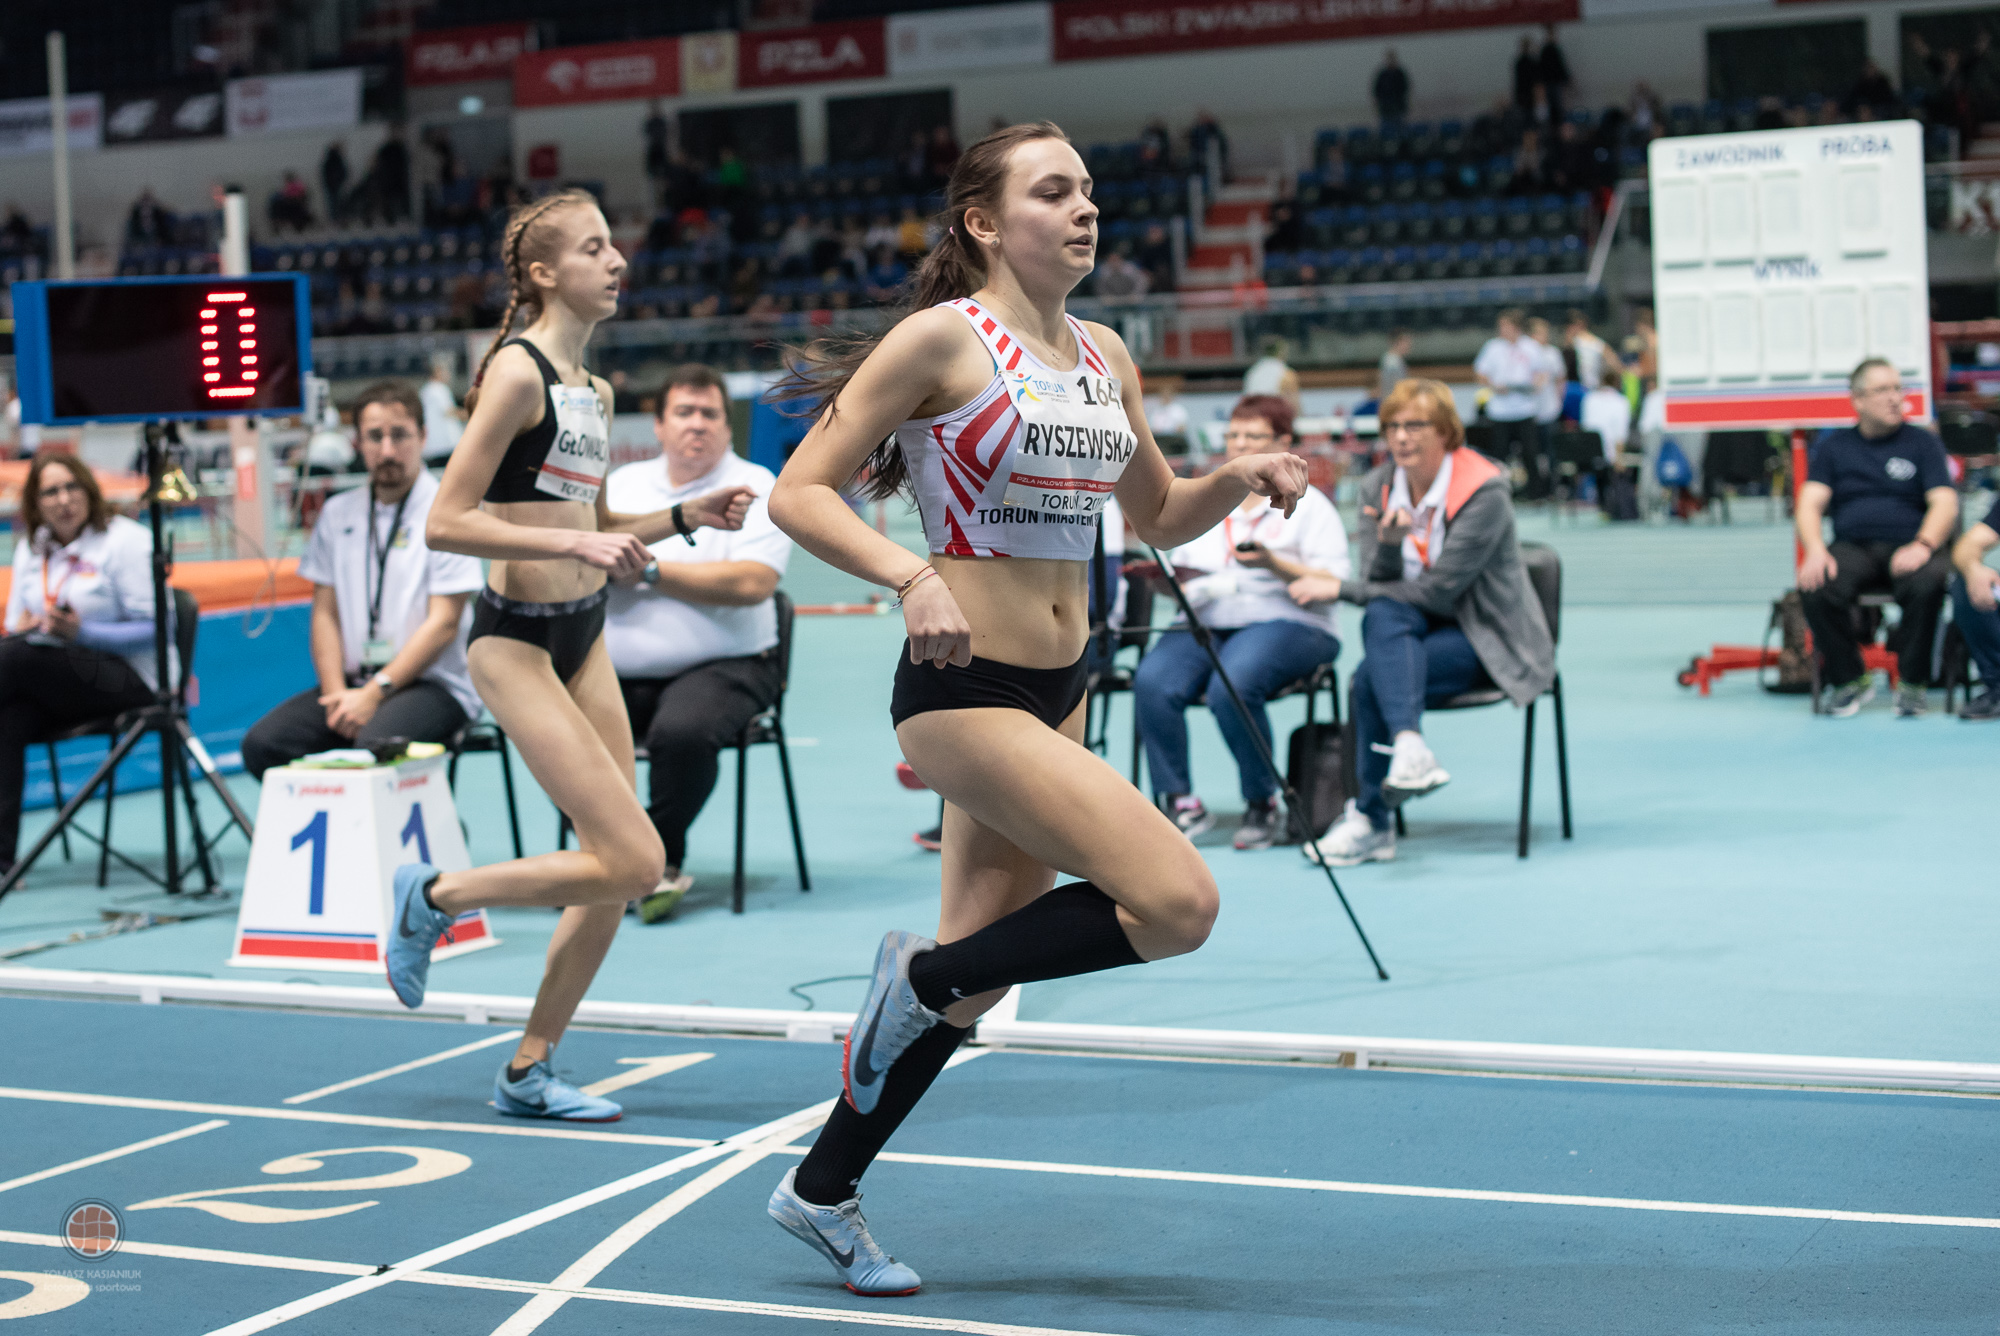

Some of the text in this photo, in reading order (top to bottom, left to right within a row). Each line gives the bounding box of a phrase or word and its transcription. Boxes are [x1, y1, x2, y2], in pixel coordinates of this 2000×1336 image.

[199, 291, 259, 397] 0
[1076, 375, 1121, 410] 164
[1024, 422, 1133, 463] RYSZEWSKA
[1016, 475, 1036, 485] PZLA
[1036, 479, 1063, 488] HALOWE
[1041, 490, 1079, 510] TORUŃ
[290, 810, 328, 915] 1
[124, 1146, 473, 1224] 2
